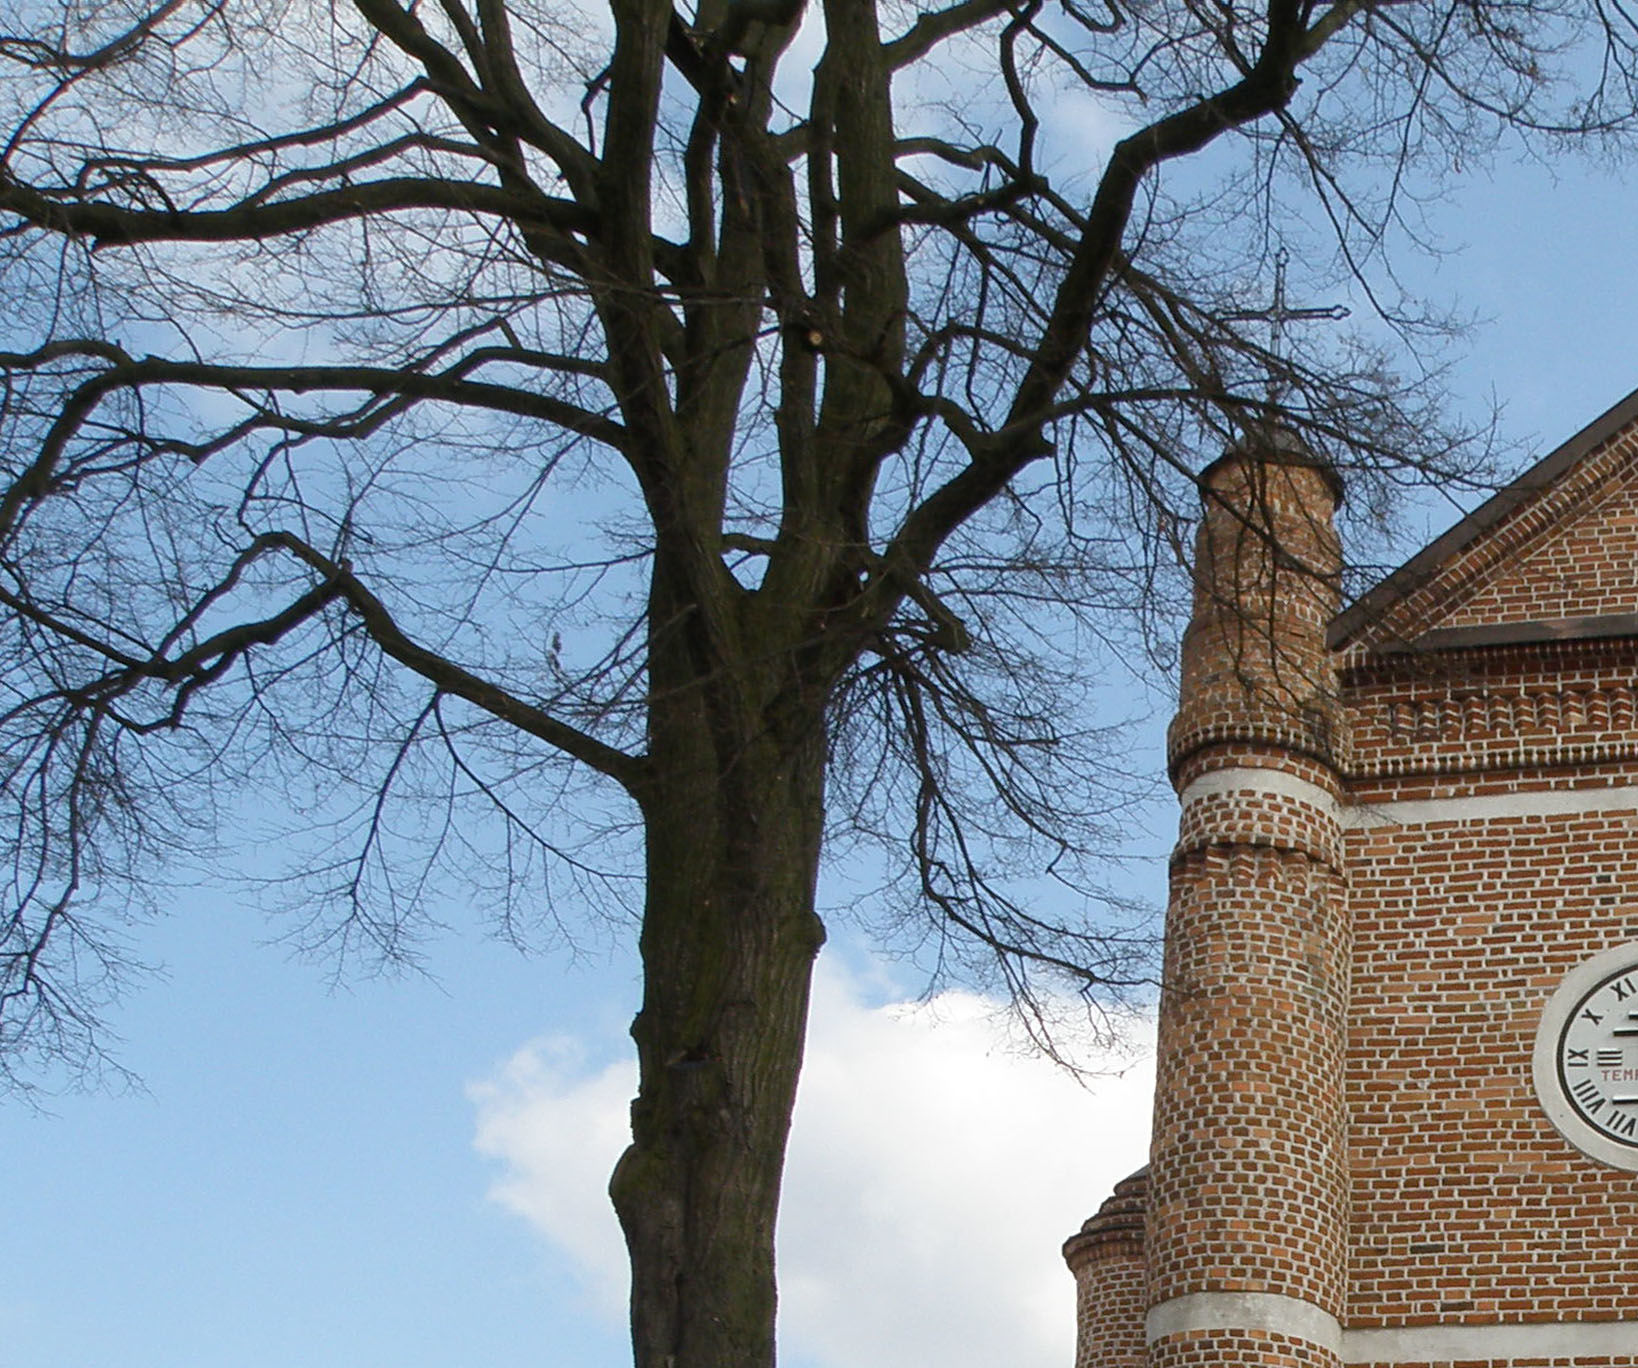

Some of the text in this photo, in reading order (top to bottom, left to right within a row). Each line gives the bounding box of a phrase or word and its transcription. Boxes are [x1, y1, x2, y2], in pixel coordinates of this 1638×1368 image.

[1610, 977, 1637, 1002] XI
[1581, 1009, 1603, 1025] X
[1568, 1048, 1589, 1067] IX
[1573, 1079, 1606, 1115] VIII
[1606, 1110, 1636, 1136] VII
